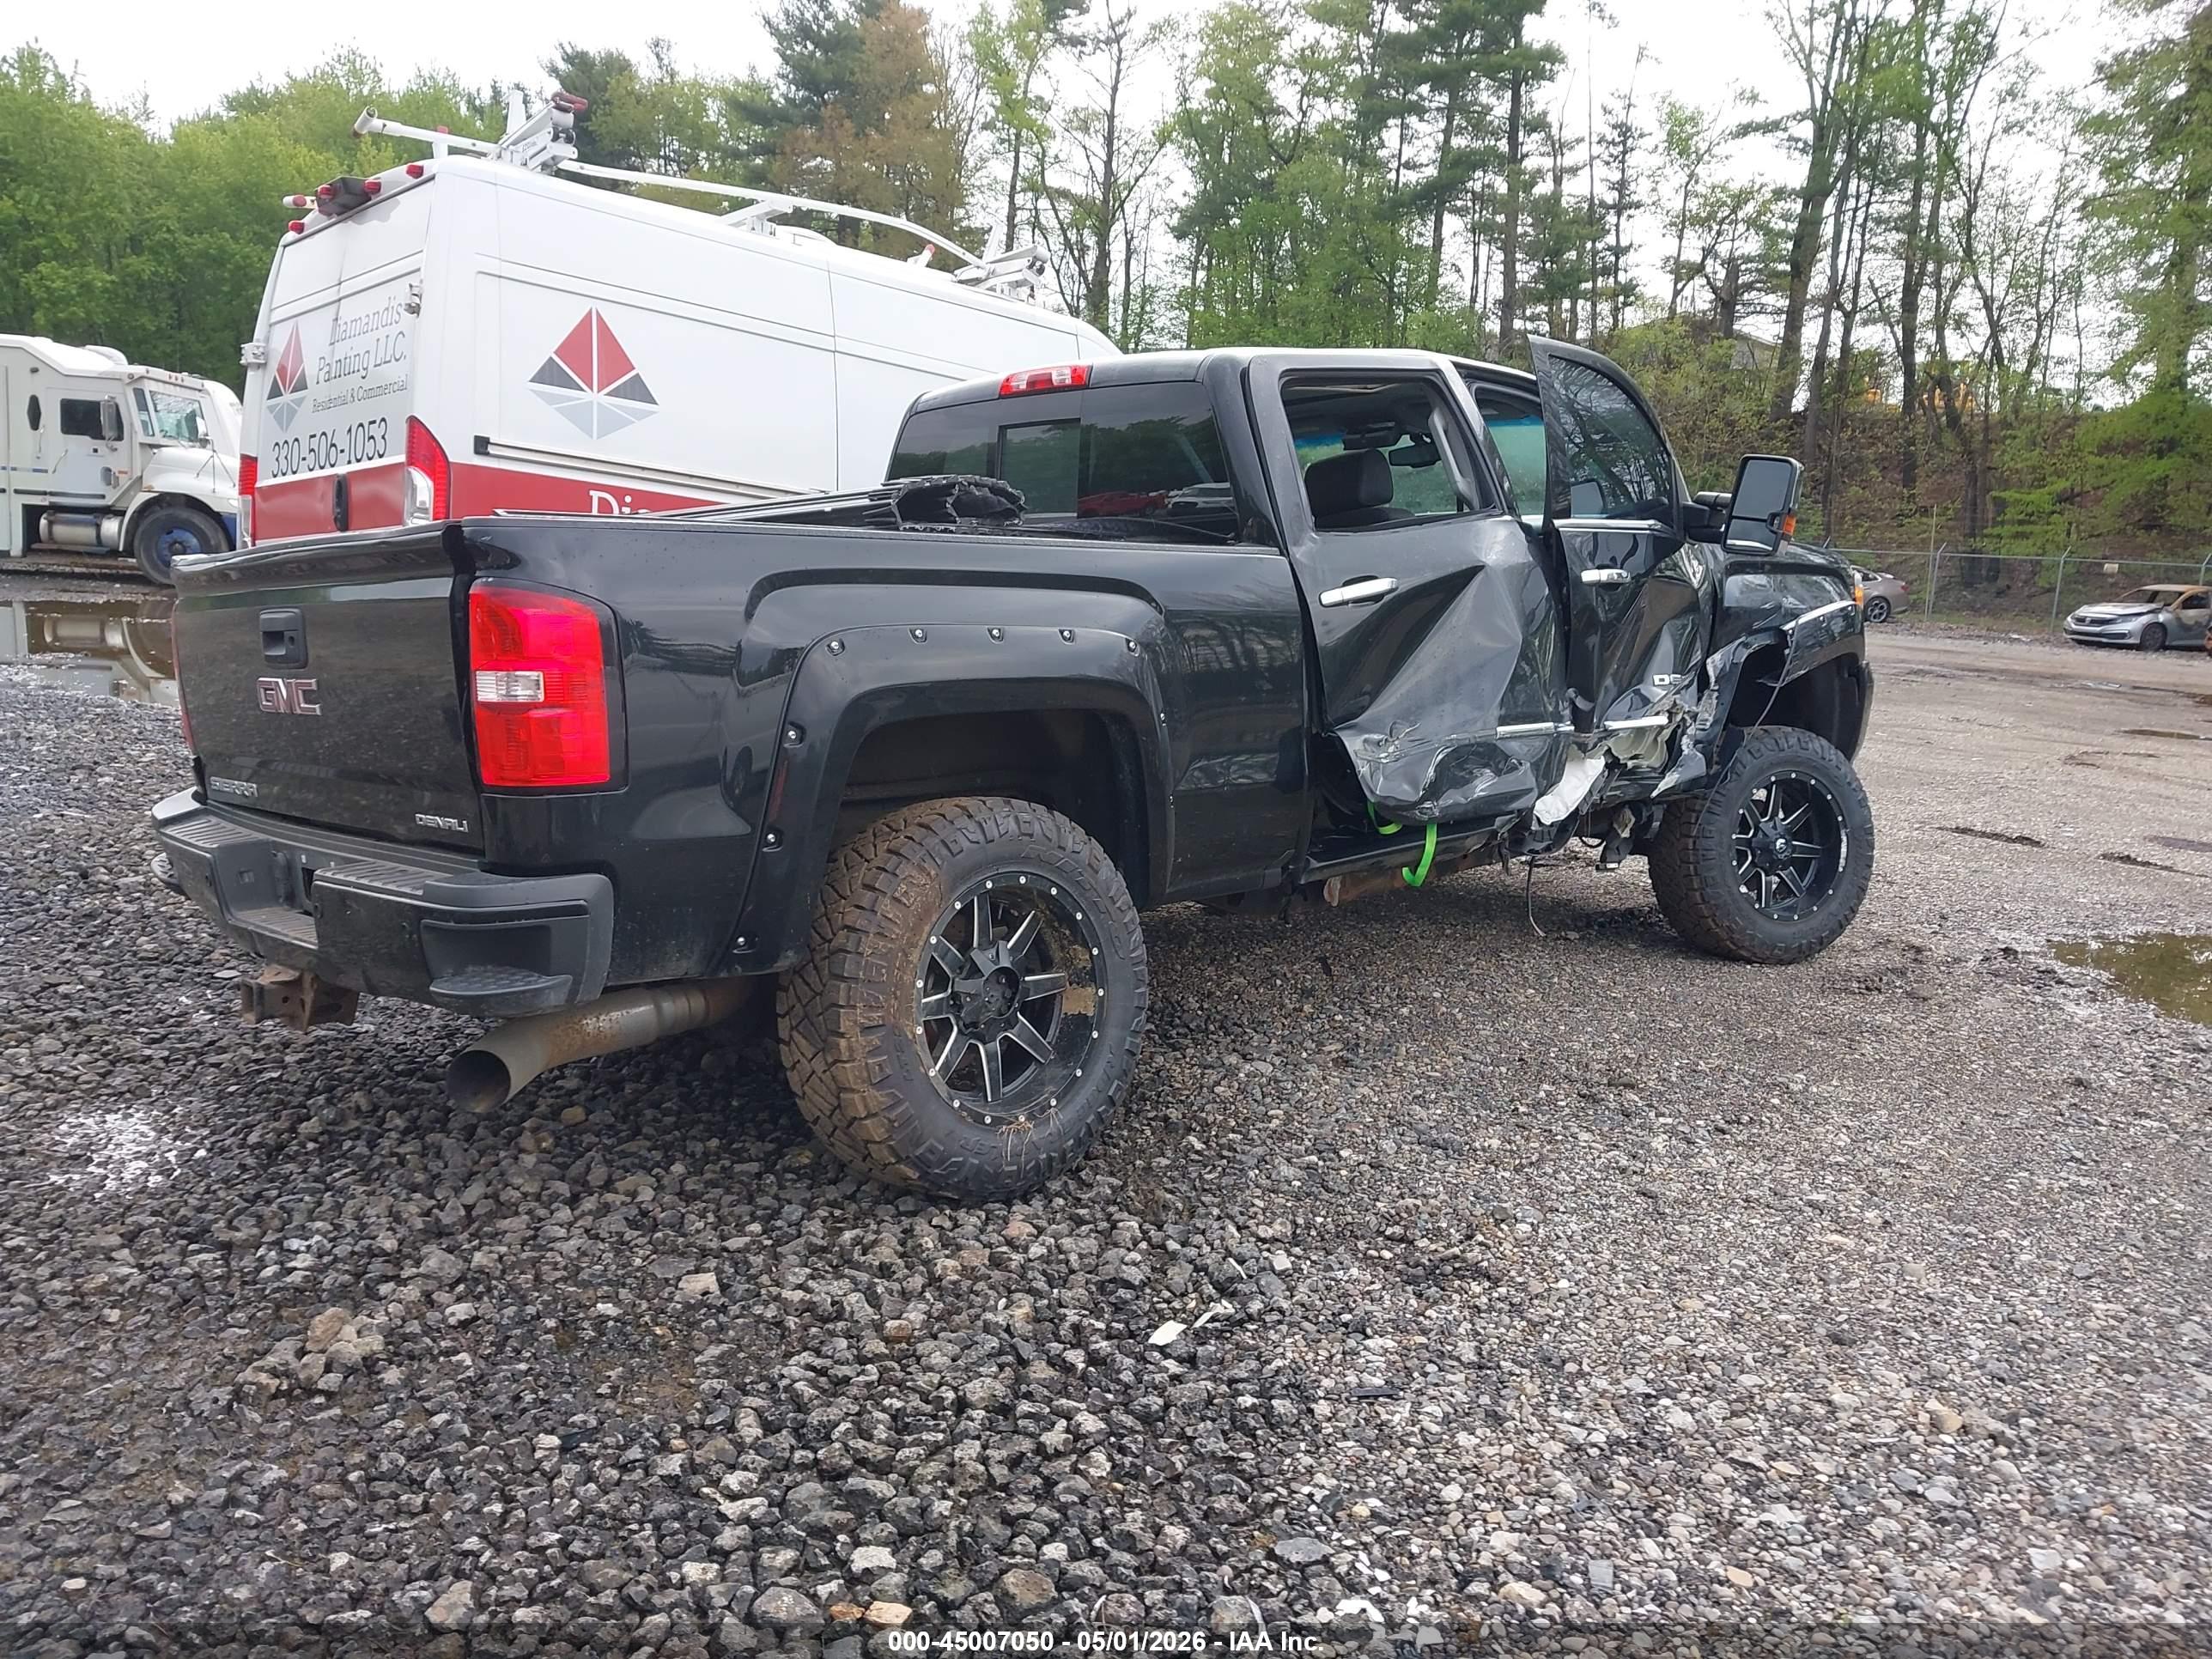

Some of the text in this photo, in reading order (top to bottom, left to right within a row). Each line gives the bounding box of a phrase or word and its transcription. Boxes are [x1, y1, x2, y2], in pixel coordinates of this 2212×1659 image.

[316, 331, 406, 385] Panting LLC.
[348, 387, 356, 404] &
[356, 374, 408, 402] Commercial
[271, 416, 388, 478] 330-506-1053
[257, 678, 322, 715] GMC
[210, 776, 258, 798] SIERRA
[415, 813, 469, 833] DENALI
